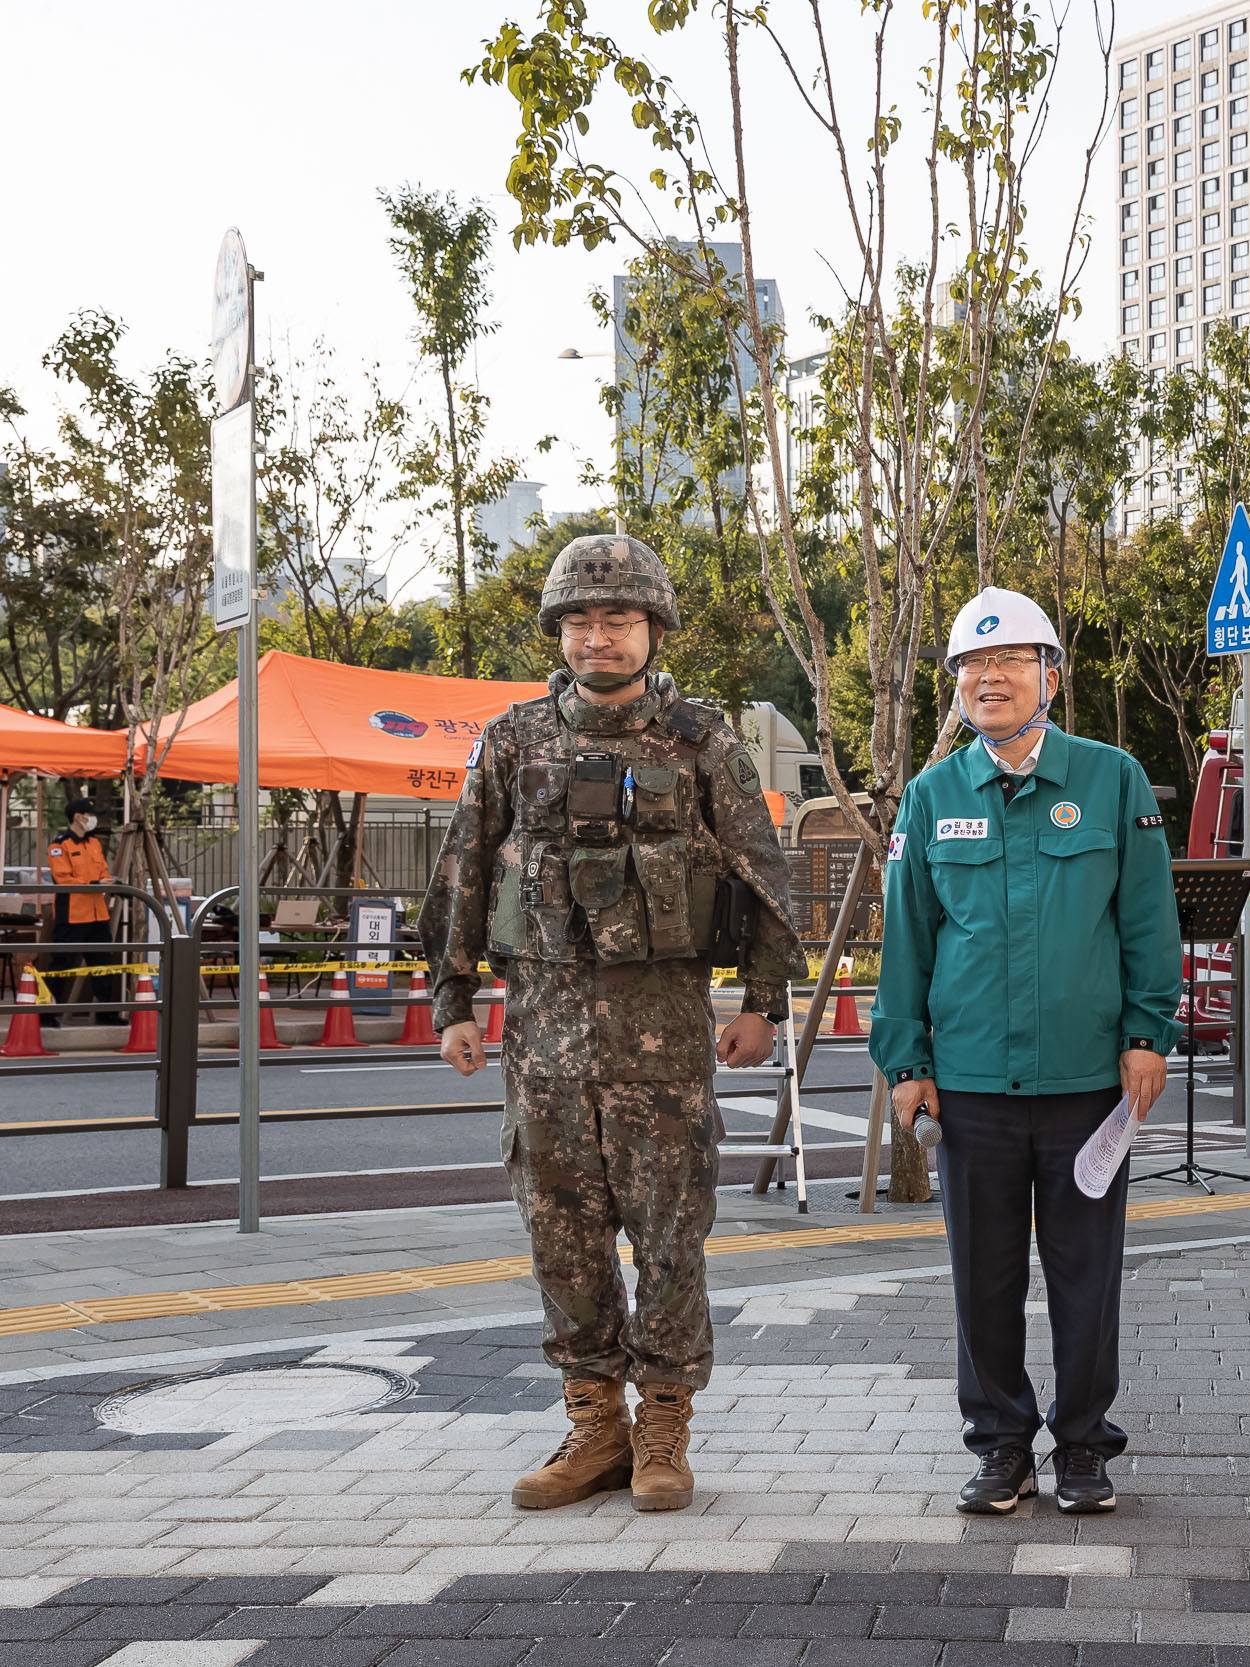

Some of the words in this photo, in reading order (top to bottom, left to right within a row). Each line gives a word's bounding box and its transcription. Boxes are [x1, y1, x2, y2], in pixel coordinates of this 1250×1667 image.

[407, 768, 459, 790] 광진구
[1140, 815, 1164, 826] 광진구
[367, 920, 380, 961] 대외력
